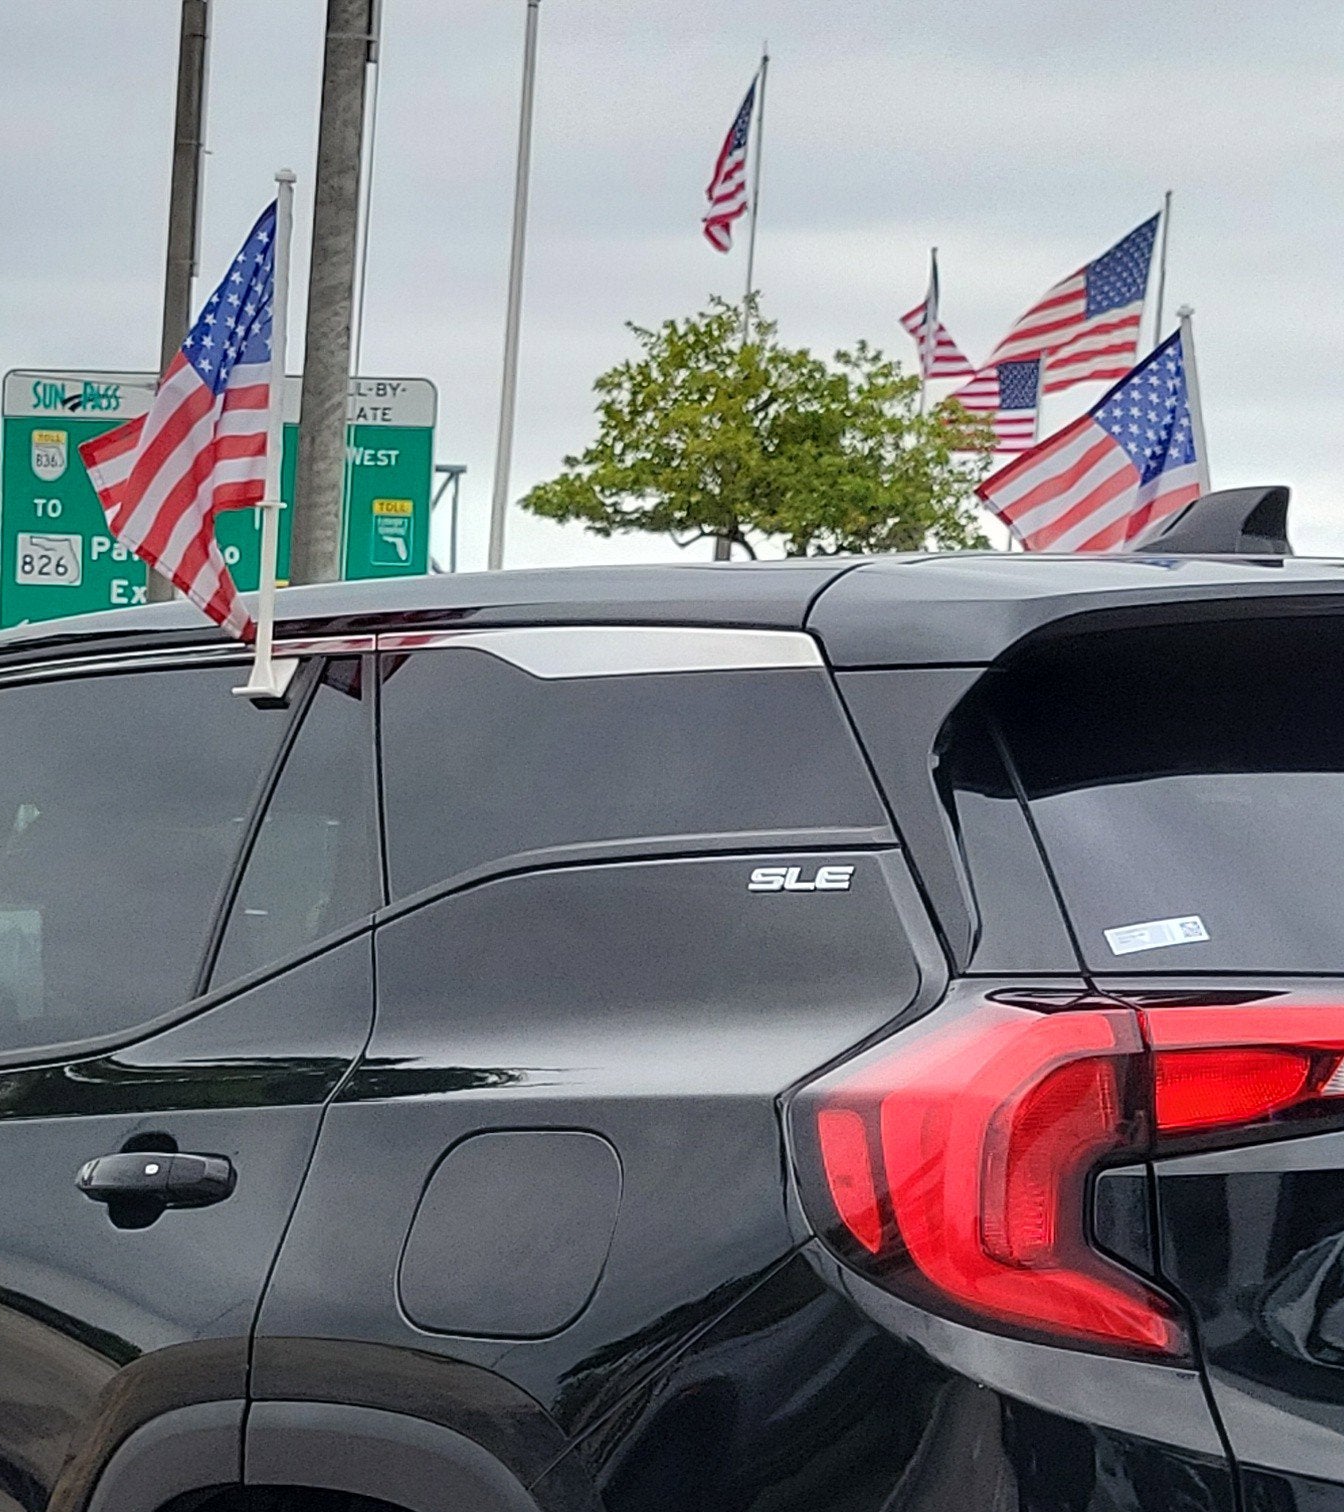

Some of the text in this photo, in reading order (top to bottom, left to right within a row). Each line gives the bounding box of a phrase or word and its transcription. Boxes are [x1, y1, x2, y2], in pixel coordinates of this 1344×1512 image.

[348, 382, 407, 398] L-BY-
[347, 406, 393, 422] ATE
[33, 498, 62, 518] TO
[20, 554, 68, 577] 826
[748, 865, 855, 891] SLE
